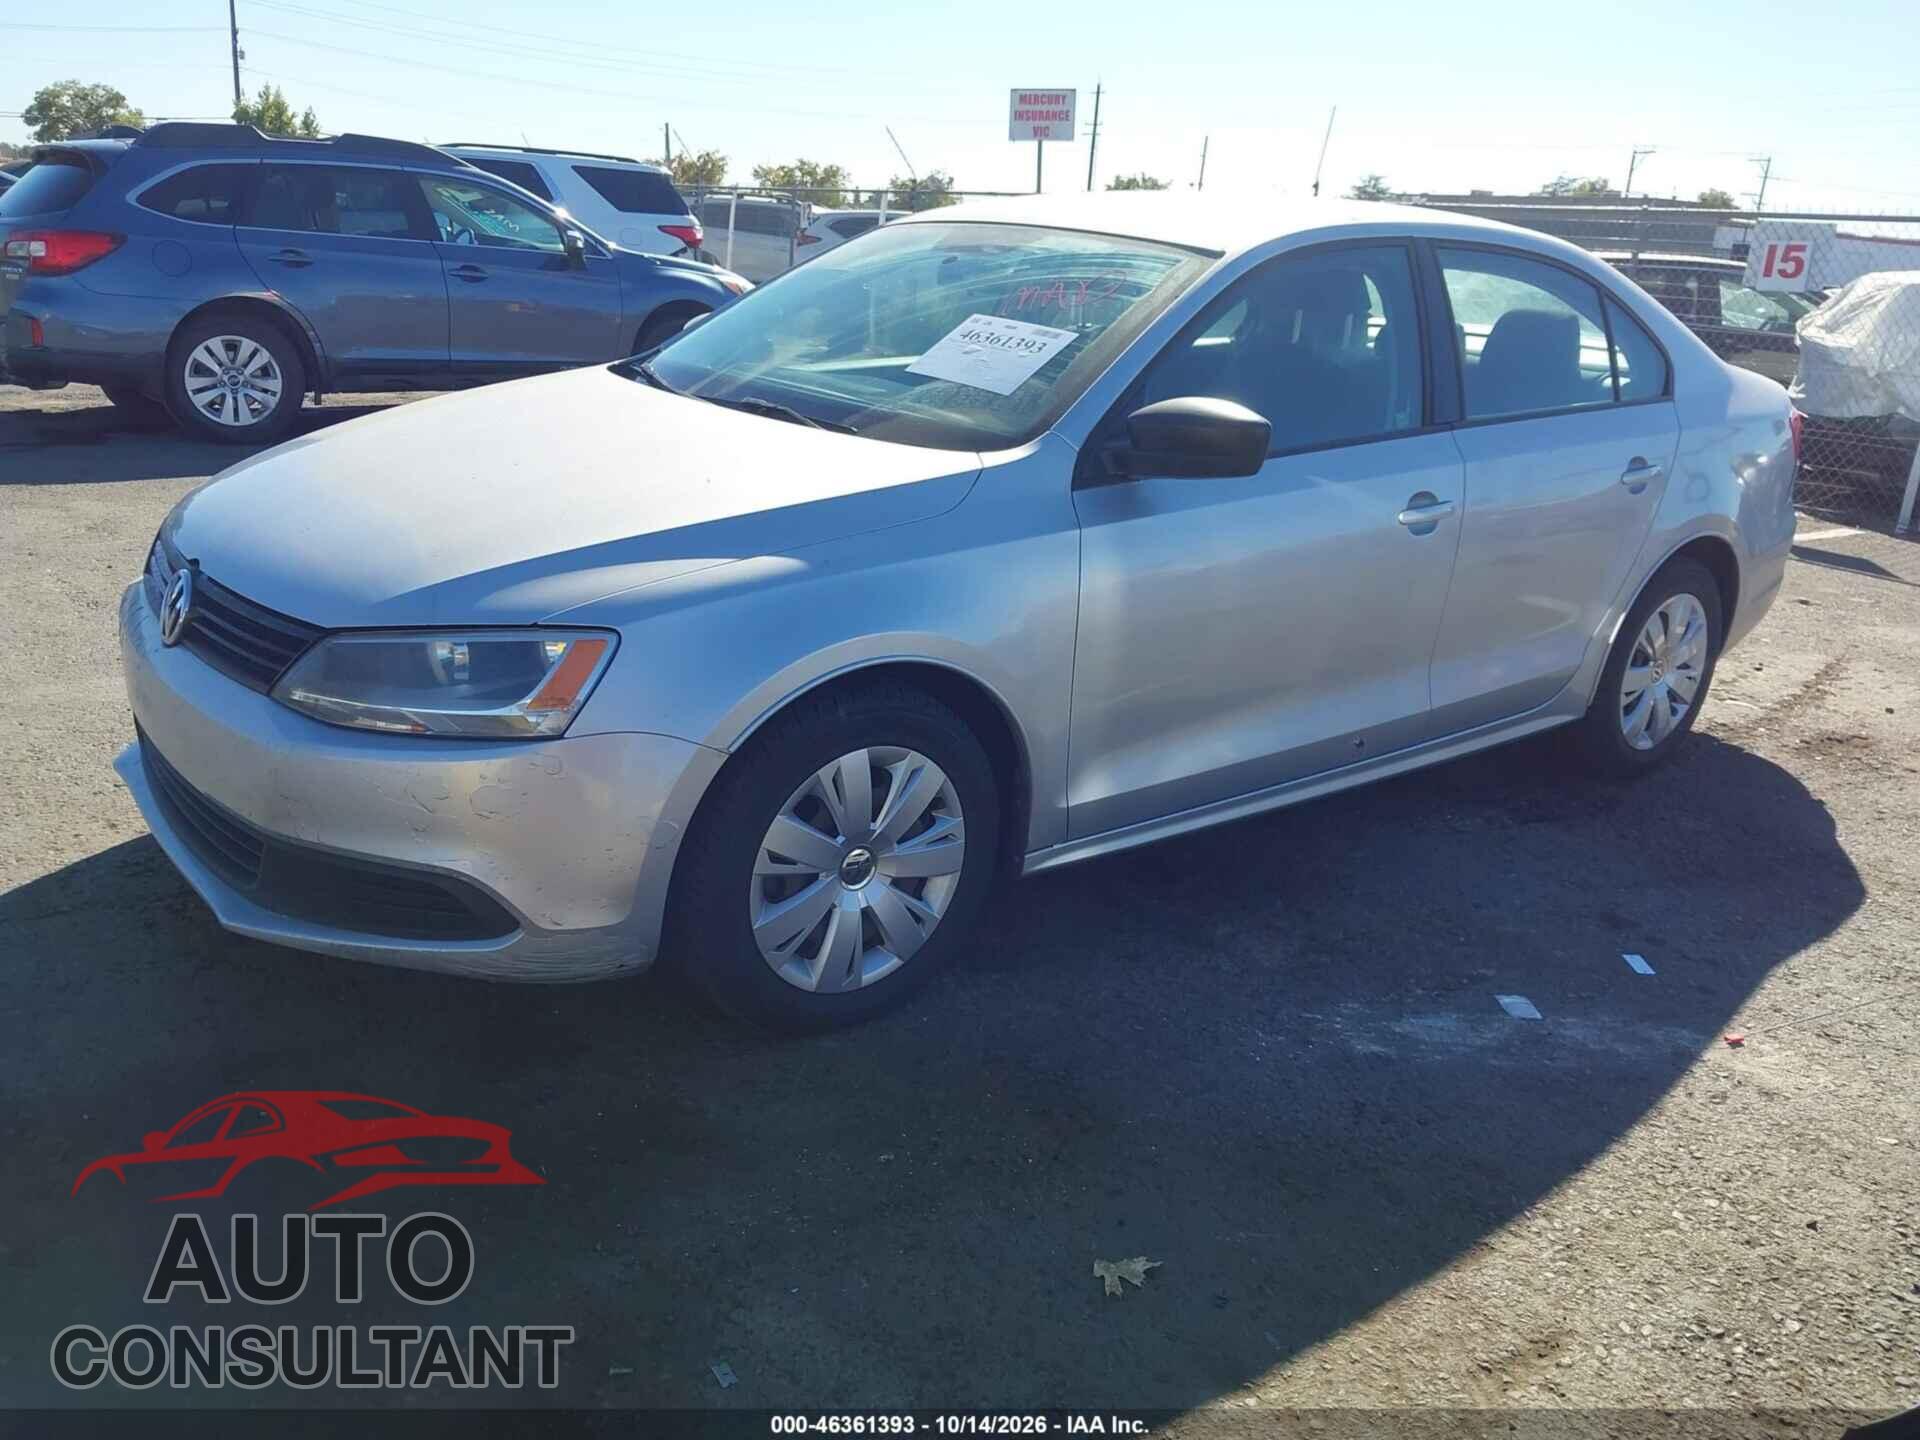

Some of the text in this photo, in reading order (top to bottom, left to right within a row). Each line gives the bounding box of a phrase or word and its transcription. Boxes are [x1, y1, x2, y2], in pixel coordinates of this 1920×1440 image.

[1019, 93, 1066, 105] MERCURY
[1014, 109, 1071, 121] INSURANCE
[1033, 126, 1050, 137] VIC
[1763, 244, 1807, 278] 15
[959, 328, 1048, 353] 46361393
